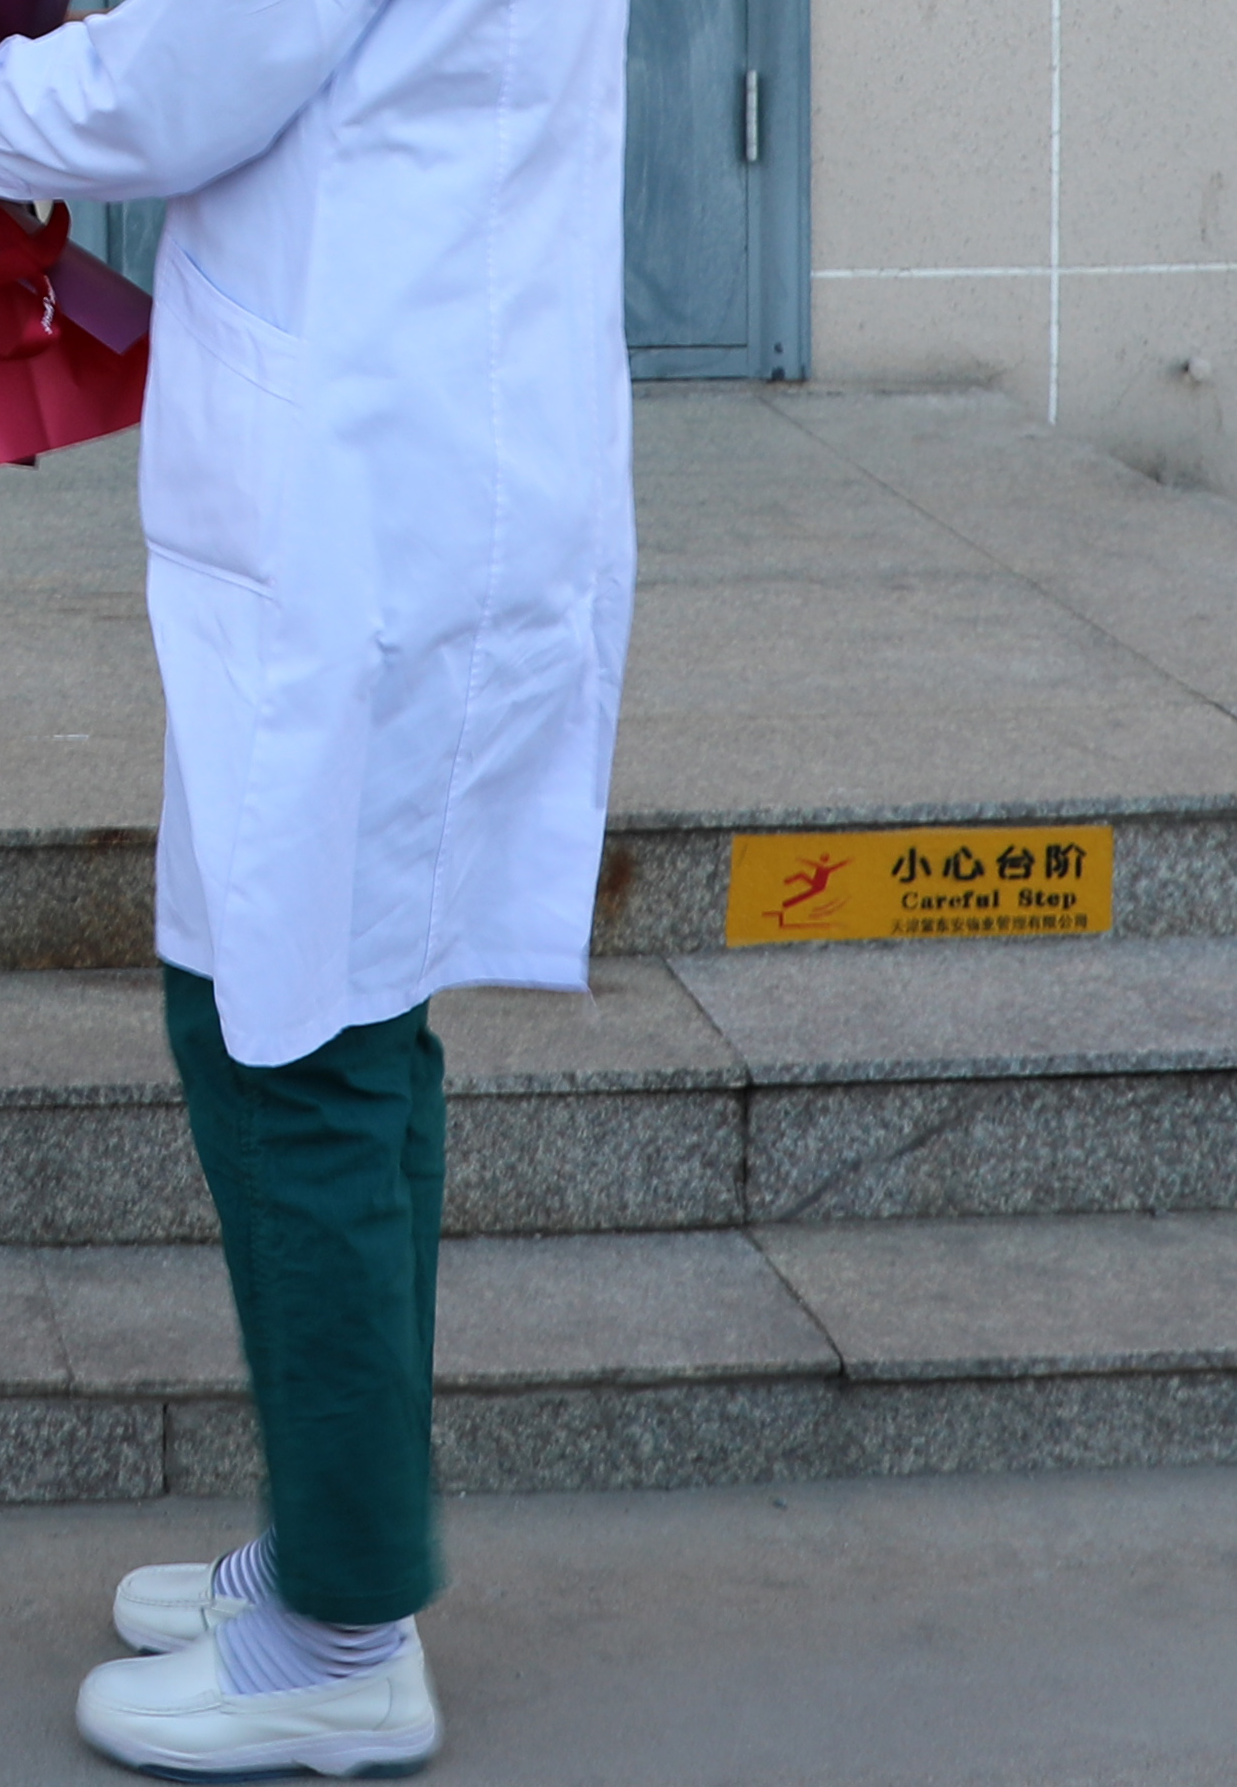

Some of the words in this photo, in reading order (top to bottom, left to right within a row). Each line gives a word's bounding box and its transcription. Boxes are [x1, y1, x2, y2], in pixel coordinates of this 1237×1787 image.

[891, 842, 1087, 883] 小心台阶
[901, 889, 1000, 910] Careful
[1018, 887, 1077, 910] Step
